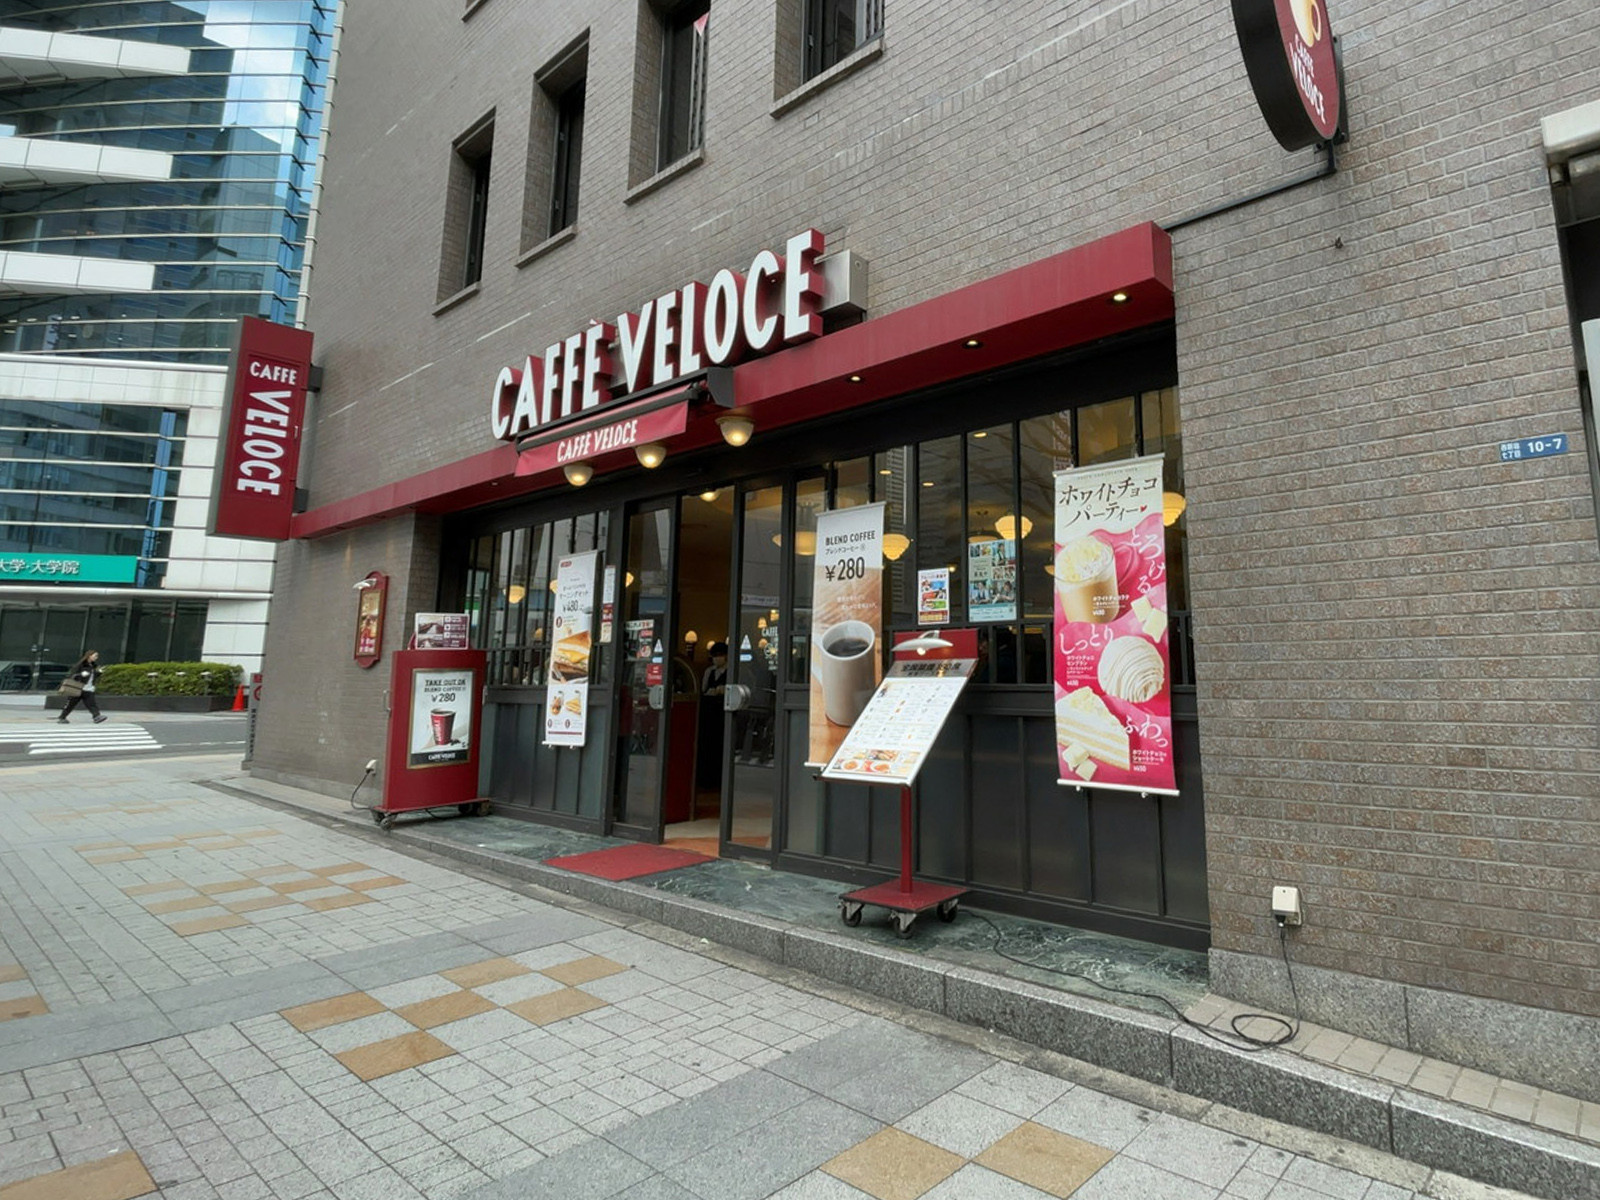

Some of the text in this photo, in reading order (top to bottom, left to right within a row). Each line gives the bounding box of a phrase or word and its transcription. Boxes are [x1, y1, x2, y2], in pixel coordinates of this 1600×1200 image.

[491, 228, 816, 440] CAFFÈ VELOCE
[250, 361, 297, 385] CAFFE
[236, 390, 292, 496] VELOCE
[593, 419, 638, 452] VELOCE
[1527, 438, 1562, 453] 10-7
[1059, 477, 1158, 506] ホワイトチョコ
[1065, 502, 1140, 529] パーティー
[825, 530, 876, 546] BLEND COFFEE
[825, 556, 865, 582] ¥280
[1059, 623, 1114, 655] しっとり
